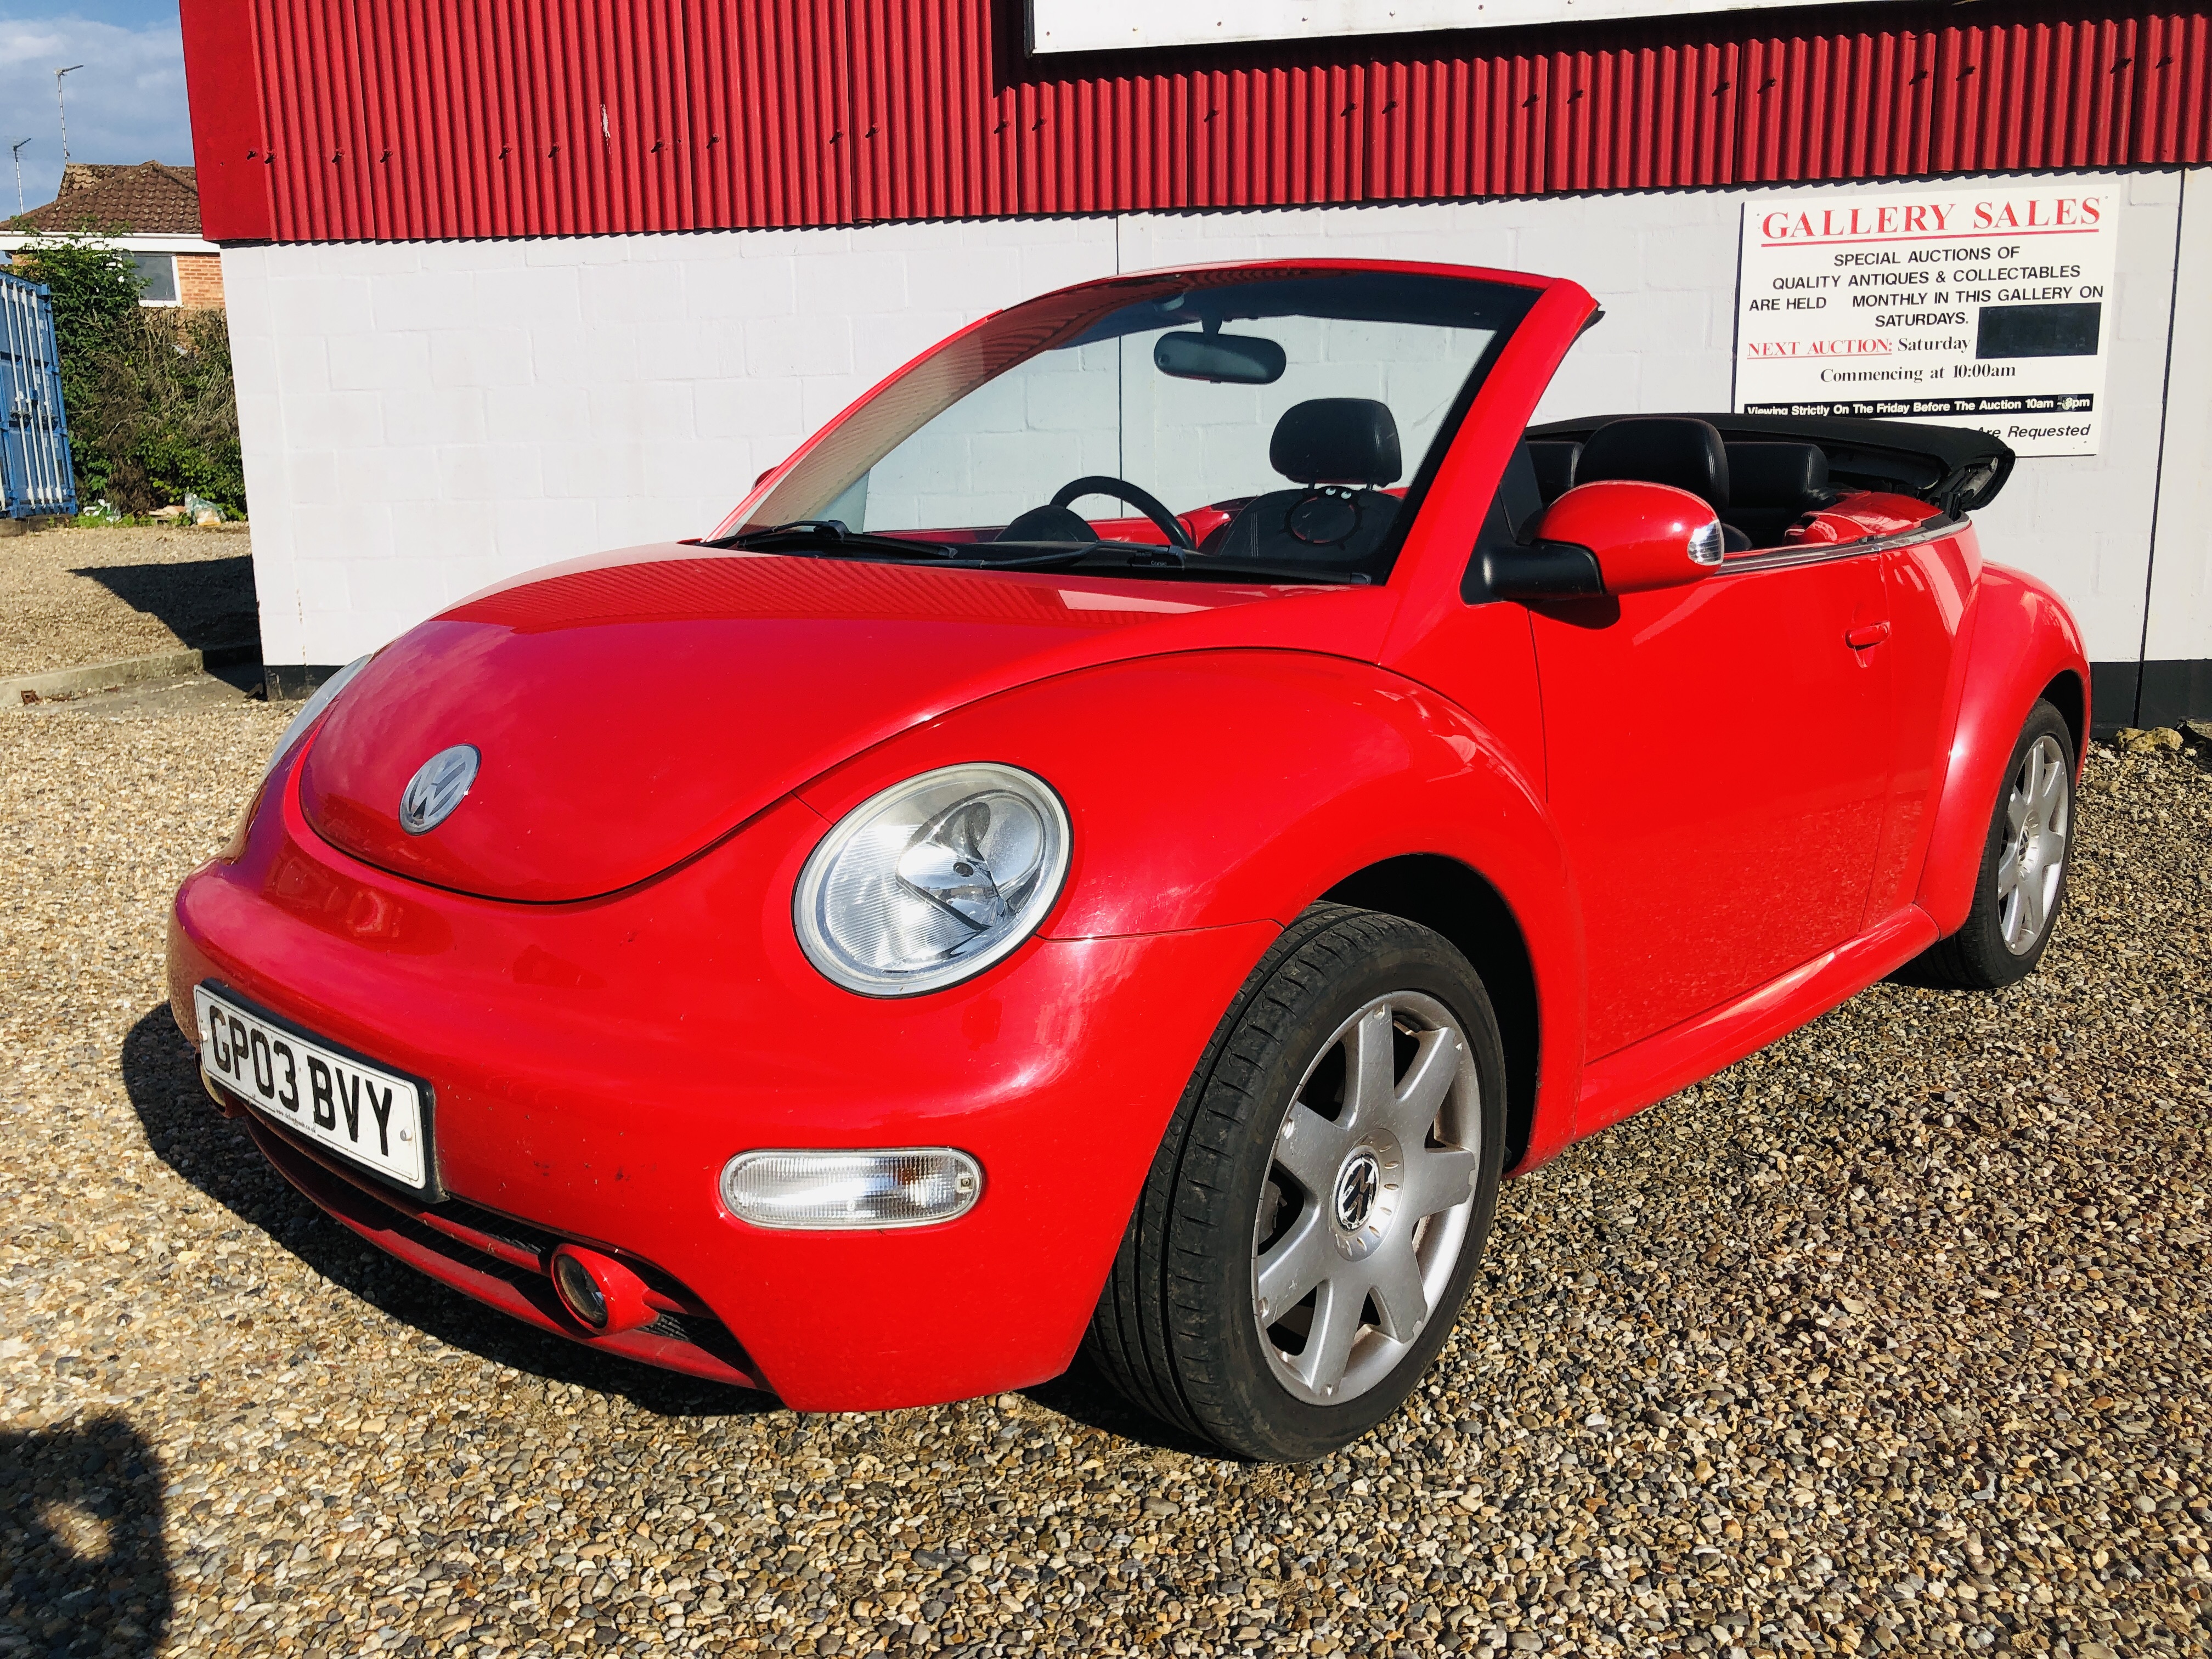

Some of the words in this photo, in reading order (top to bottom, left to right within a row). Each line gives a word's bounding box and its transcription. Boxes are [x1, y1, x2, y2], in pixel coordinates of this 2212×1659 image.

[1762, 203, 1956, 239] GALLERY
[1973, 196, 2101, 229] SALES
[1833, 251, 1901, 267] SPECIAL
[1908, 247, 1991, 263] AUCTIONS
[1997, 246, 2020, 259] OF
[1773, 275, 1841, 290] QUALITY
[1848, 271, 1929, 287] ANTIQUES
[1936, 270, 1946, 283] &
[1953, 265, 2081, 283] COLLECTABLES
[1749, 297, 1780, 312] ARE
[1786, 296, 1827, 310] HELD
[1852, 292, 1928, 308] MONTHLY
[1934, 291, 1949, 304] IN
[1955, 290, 1991, 303] THIS
[1997, 286, 2073, 302] GALLERY
[2079, 285, 2103, 299] ON
[1875, 312, 1968, 328] SATURDAYS.
[1747, 341, 1800, 357] NEXT
[1807, 338, 1893, 355] AUCTION:
[1897, 336, 1971, 353] Saturday
[1820, 366, 1923, 383] Commencing
[1930, 366, 1945, 379] at
[1953, 363, 2016, 379] 10:00am
[1791, 405, 1830, 416] Strictly
[1833, 404, 1849, 414] On
[1852, 404, 1874, 414] The
[1876, 403, 1910, 415] Friday
[1913, 402, 1950, 413] Before
[1954, 400, 1976, 411] The
[1979, 399, 2022, 410] Auction
[2025, 398, 2054, 409] 10am
[2007, 424, 2091, 441] Requested
[209, 1004, 300, 1114] GP03
[306, 1053, 393, 1157] BVY
